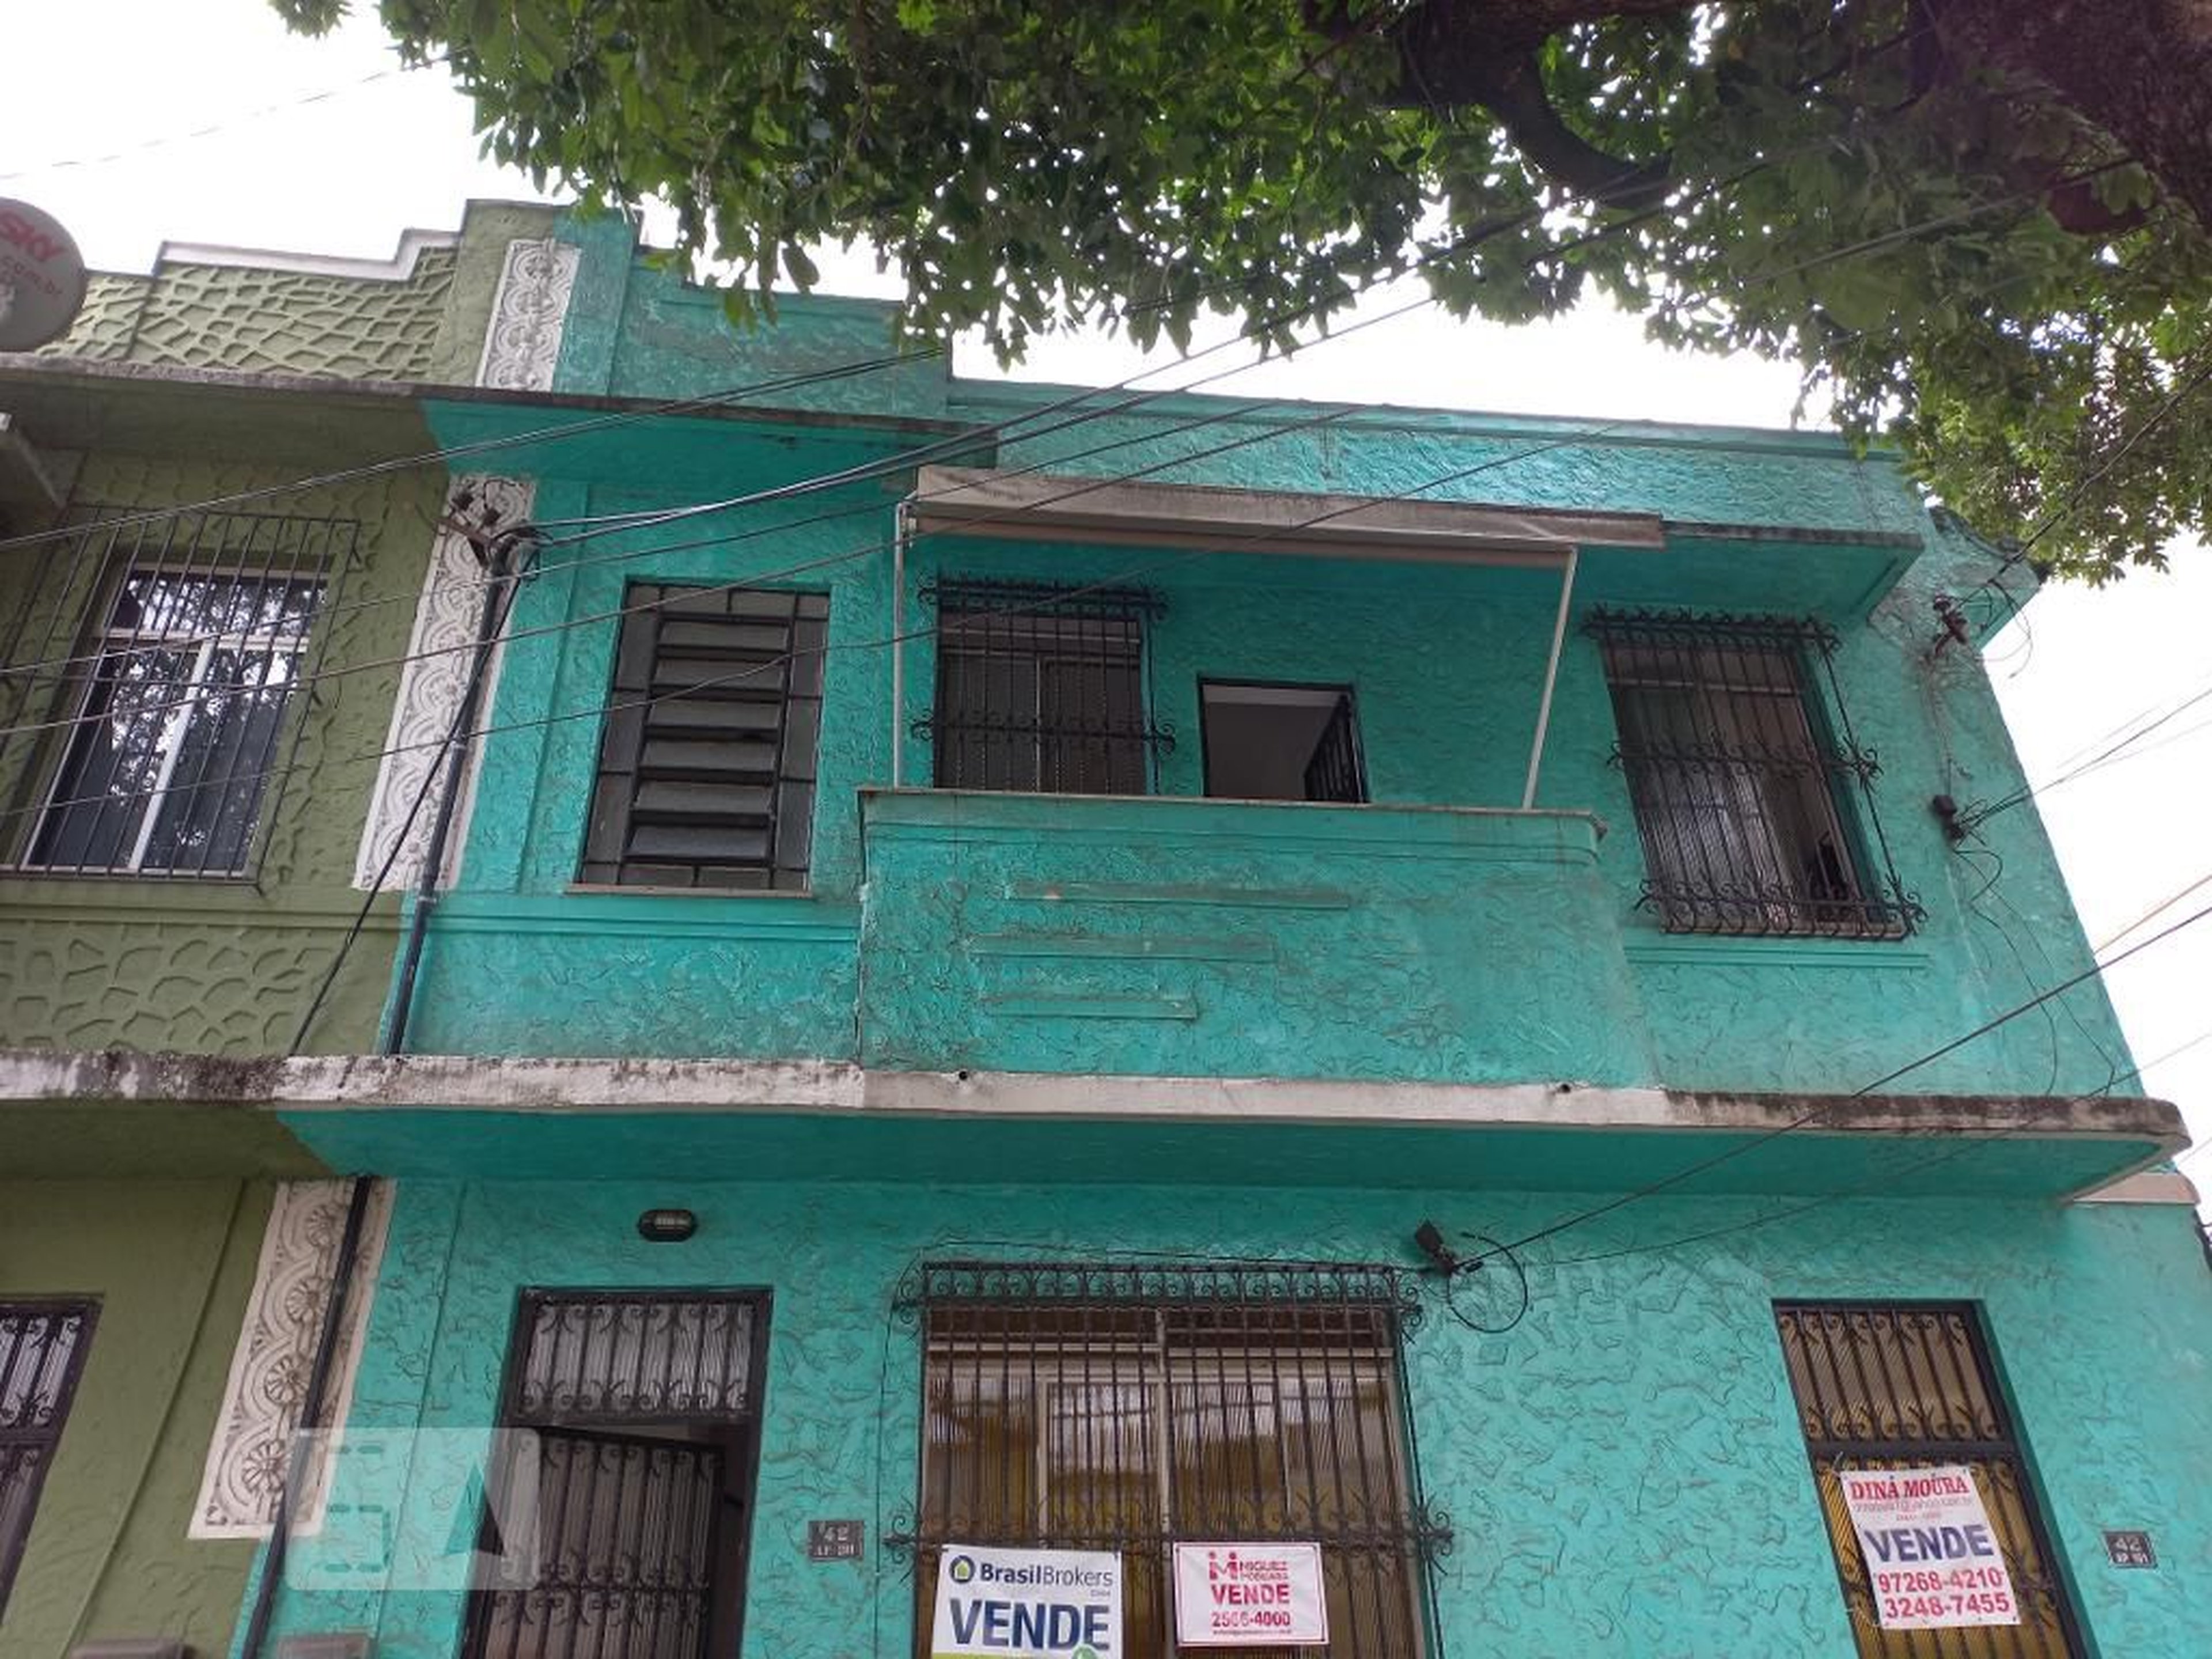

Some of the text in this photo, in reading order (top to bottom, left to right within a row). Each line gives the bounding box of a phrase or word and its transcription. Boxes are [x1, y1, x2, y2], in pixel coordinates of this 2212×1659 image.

[1903, 1476, 1970, 1498] MOURA
[1864, 1524, 1995, 1562] VENDE
[980, 1562, 1113, 1587] BrasilBrokers
[1878, 1567, 2003, 1593] 97268-4210
[1211, 1584, 1290, 1605] VENDE
[1885, 1592, 2010, 1619] 3248-7455
[950, 1597, 1111, 1651] VENDE
